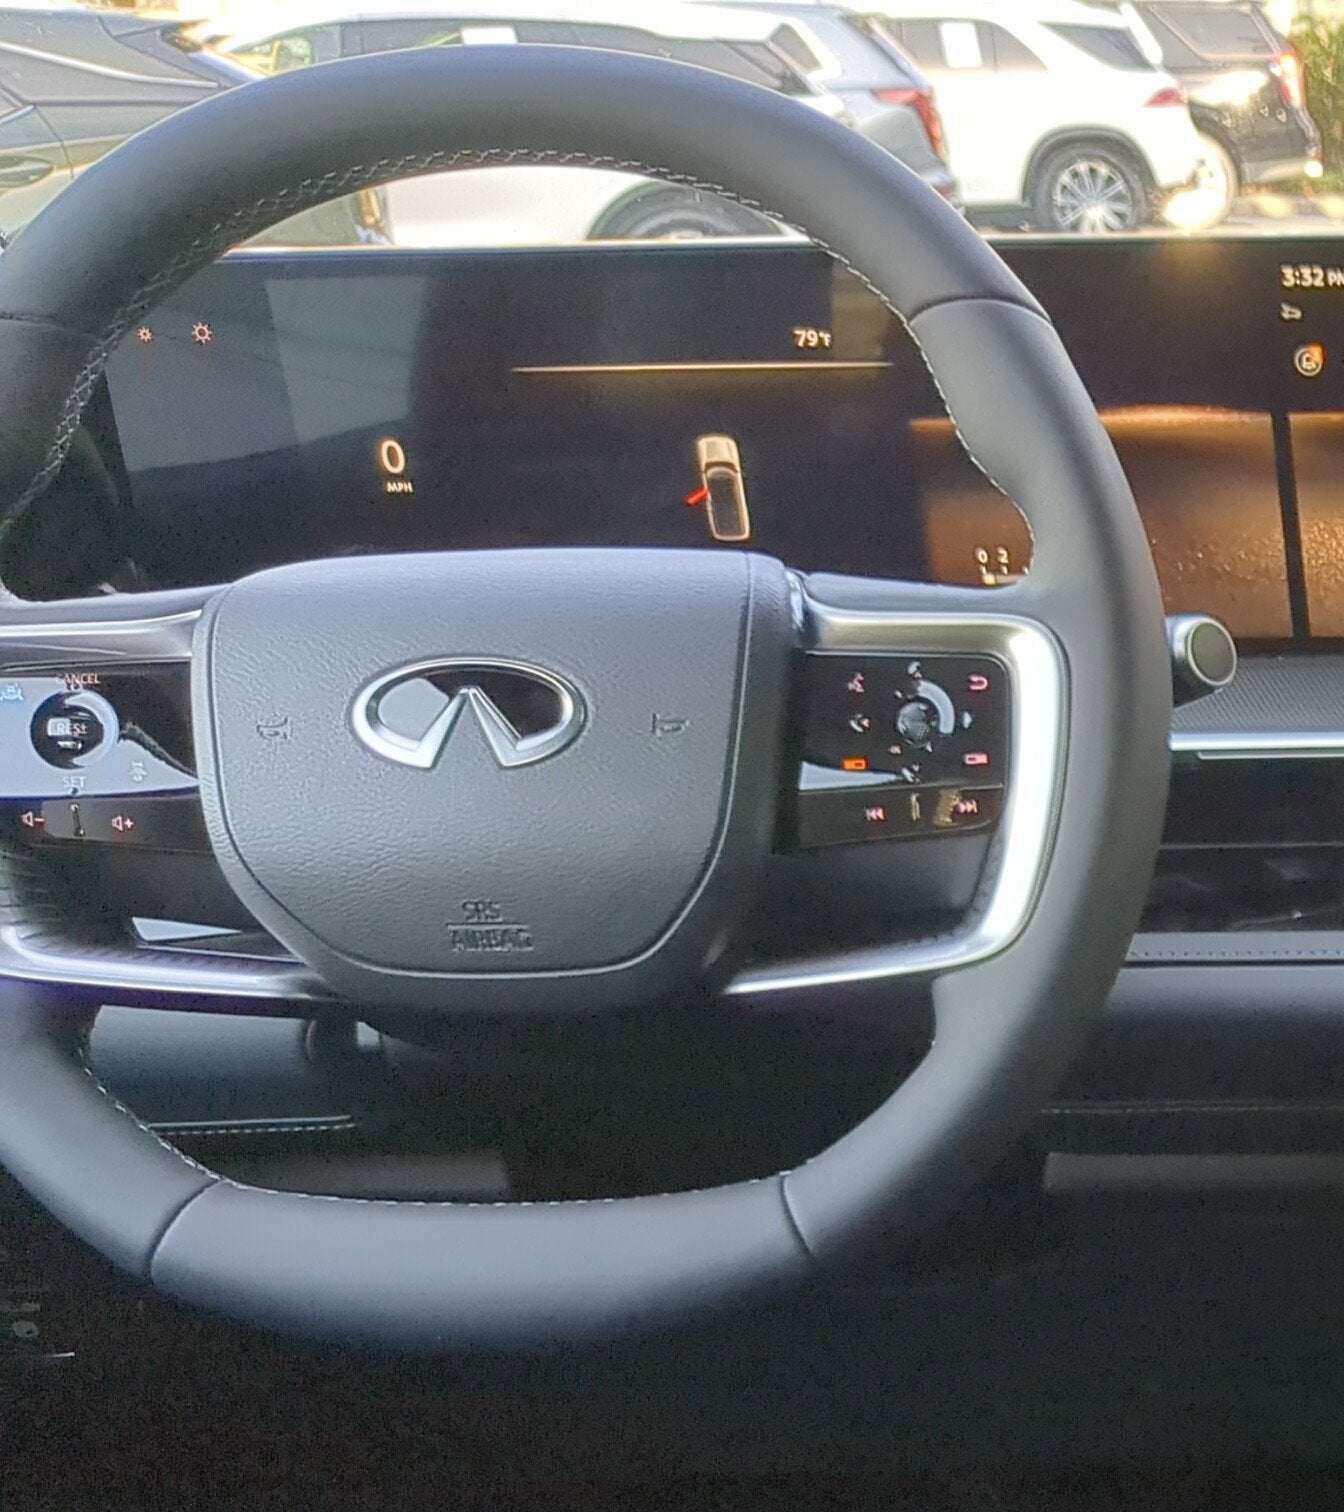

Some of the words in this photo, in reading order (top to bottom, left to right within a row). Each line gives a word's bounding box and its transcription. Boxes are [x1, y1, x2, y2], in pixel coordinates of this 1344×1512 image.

[1280, 264, 1324, 287] 3:32
[381, 440, 405, 474] 0
[386, 482, 413, 493] MPH
